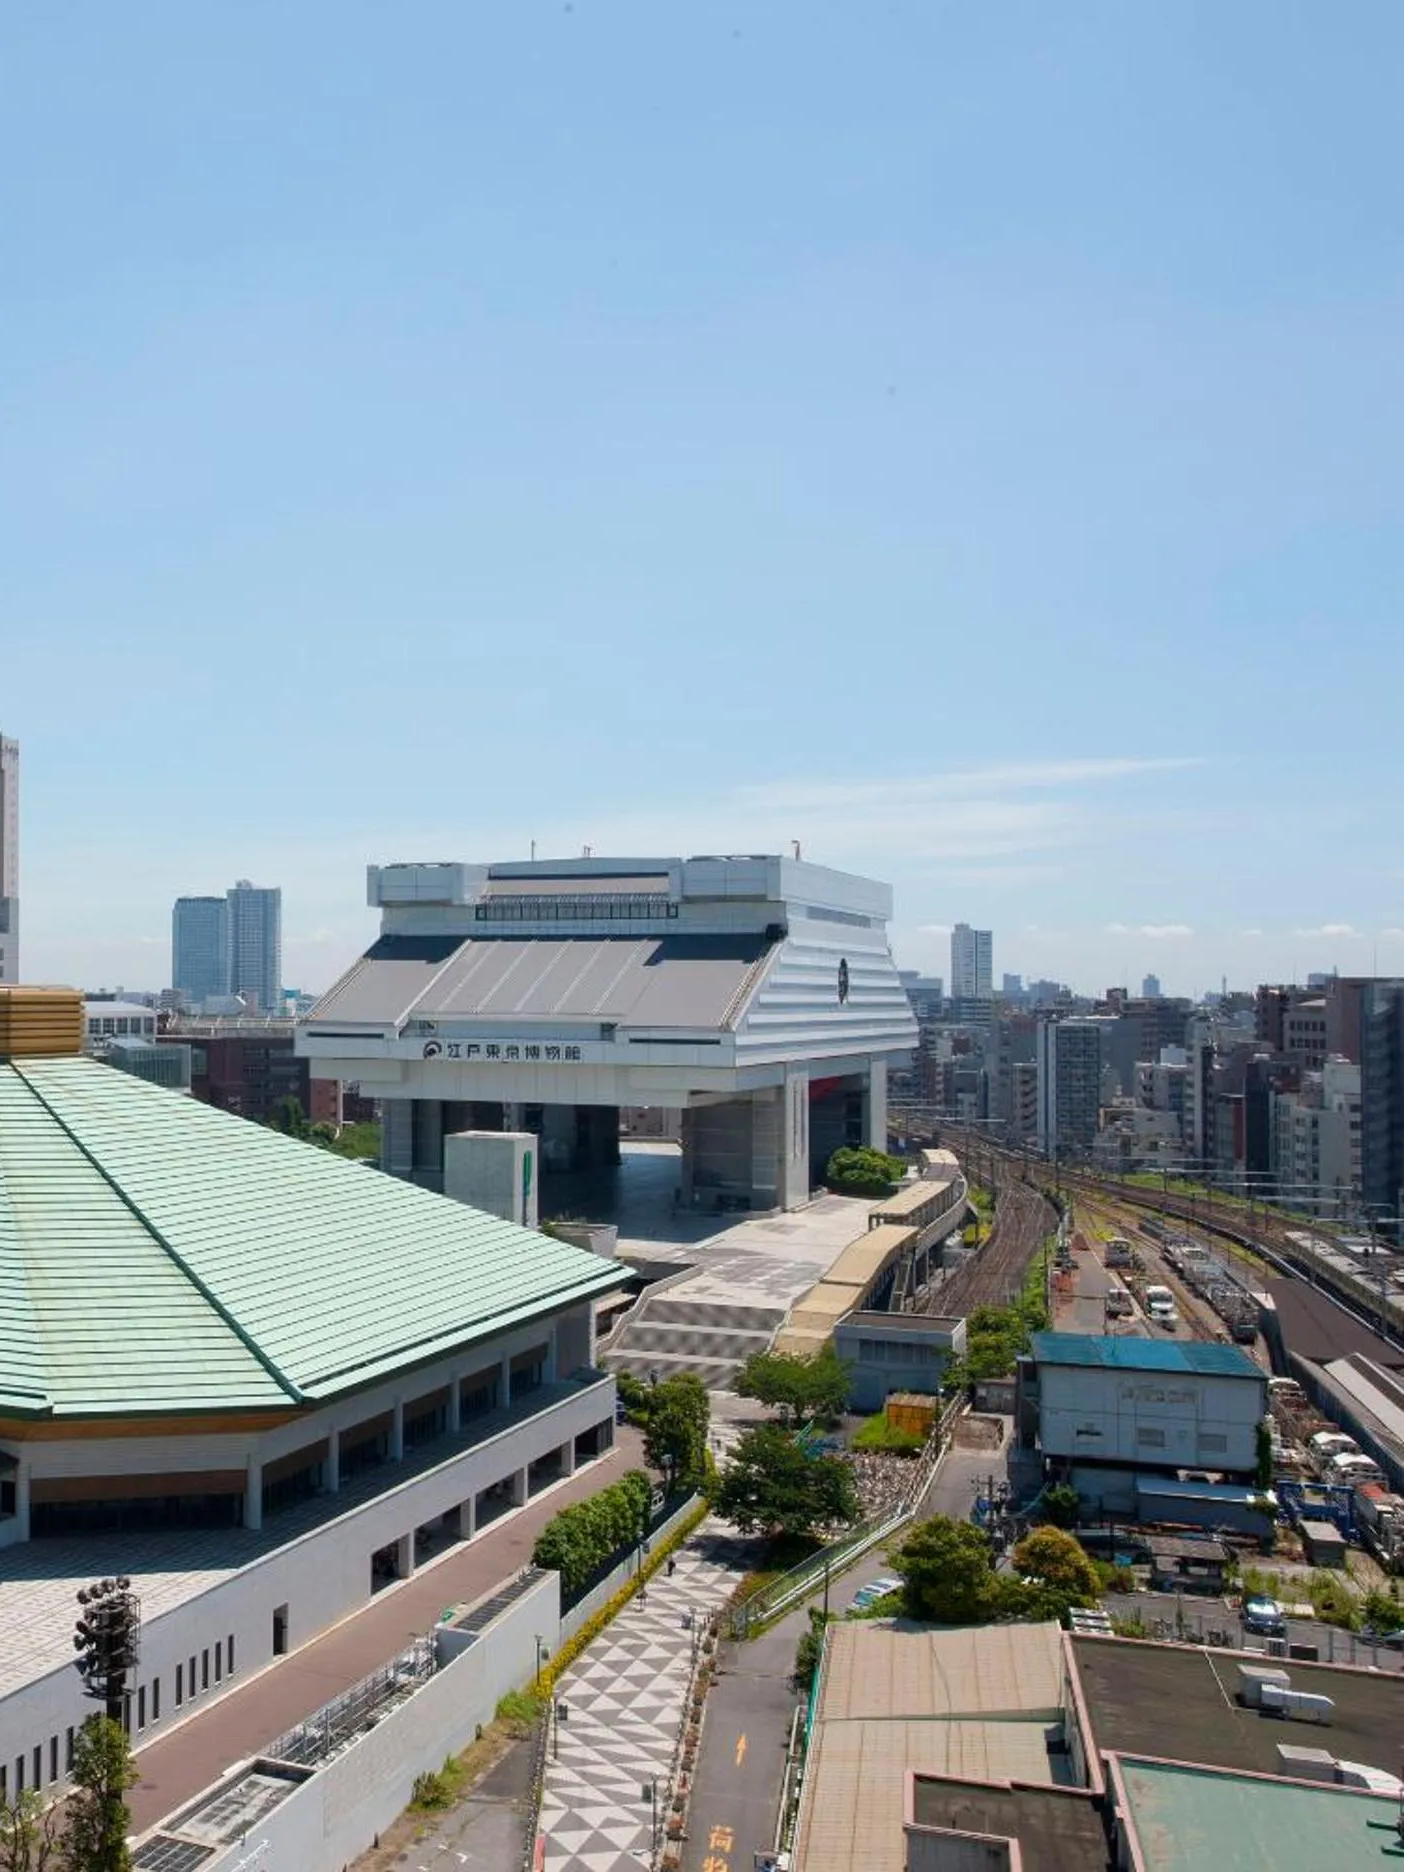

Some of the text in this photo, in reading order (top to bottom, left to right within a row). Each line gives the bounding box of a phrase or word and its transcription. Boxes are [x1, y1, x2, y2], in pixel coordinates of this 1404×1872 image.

[447, 1043, 581, 1061] 江戸東京博物館
